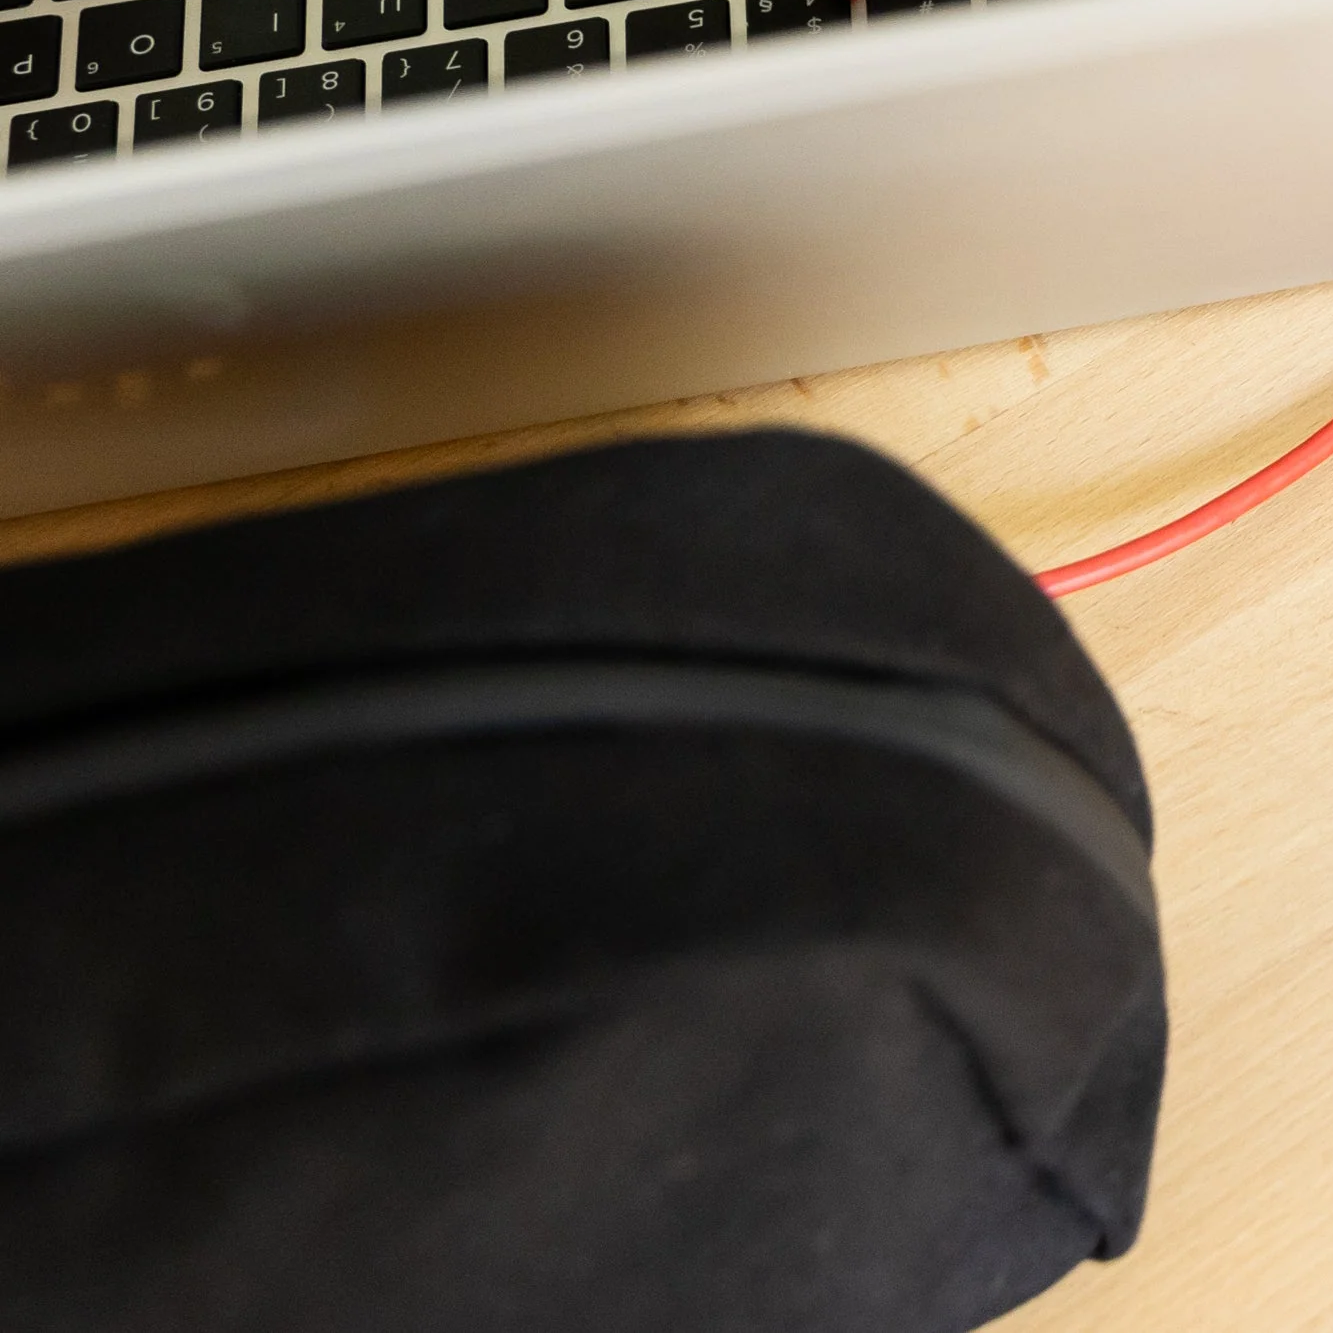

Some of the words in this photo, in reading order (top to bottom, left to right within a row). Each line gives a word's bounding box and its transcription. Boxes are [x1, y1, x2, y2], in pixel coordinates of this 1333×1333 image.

[272, 12, 279, 33] I
[333, 19, 347, 33] 4
[688, 8, 705, 29] 5
[129, 33, 156, 55] O
[210, 41, 224, 55] 5
[566, 29, 584, 49] 6
[12, 53, 34, 76] P
[86, 61, 100, 75] 6
[399, 58, 412, 78] {
[445, 50, 462, 70] 7
[274, 77, 287, 99] [
[321, 71, 340, 90] 8
[150, 98, 162, 121] ]
[197, 92, 215, 112] 9
[26, 119, 40, 141] }
